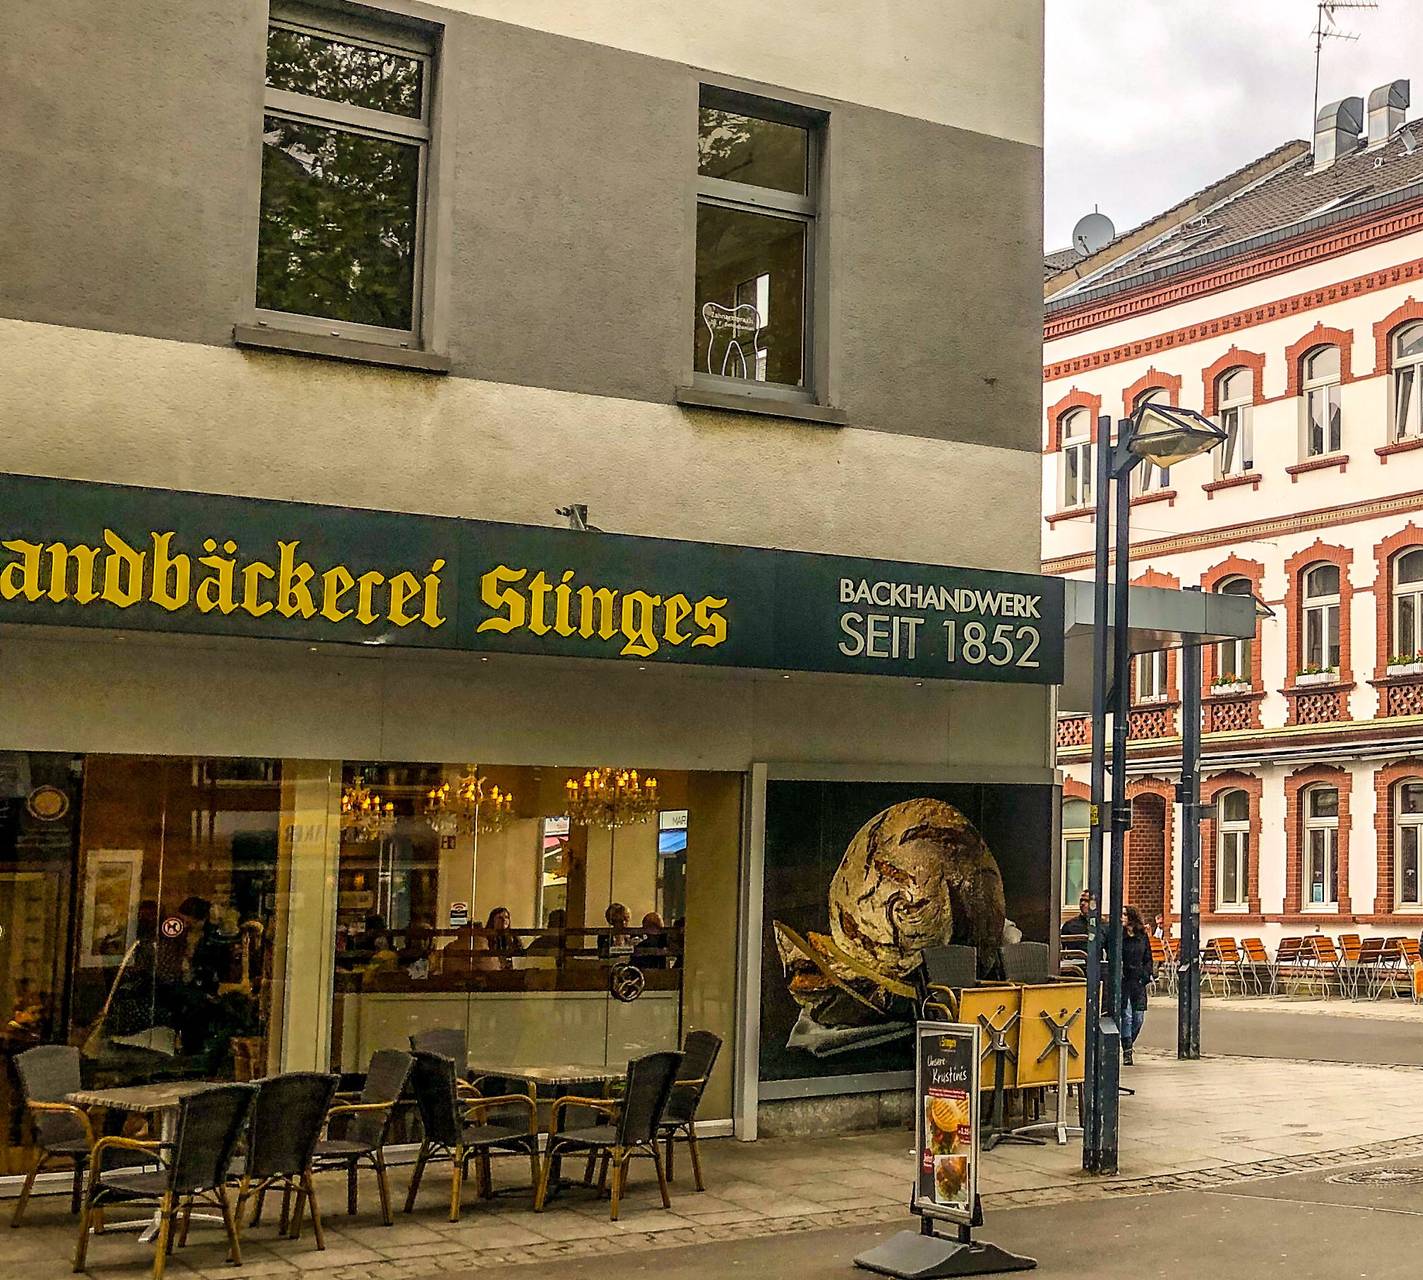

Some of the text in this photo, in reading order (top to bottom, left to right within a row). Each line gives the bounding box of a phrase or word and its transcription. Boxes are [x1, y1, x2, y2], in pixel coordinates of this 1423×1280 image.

[0, 528, 729, 658] andbäckerei Stinges
[839, 577, 1042, 619] BACKHANDWERK
[838, 611, 1041, 668] SEIT 1852
